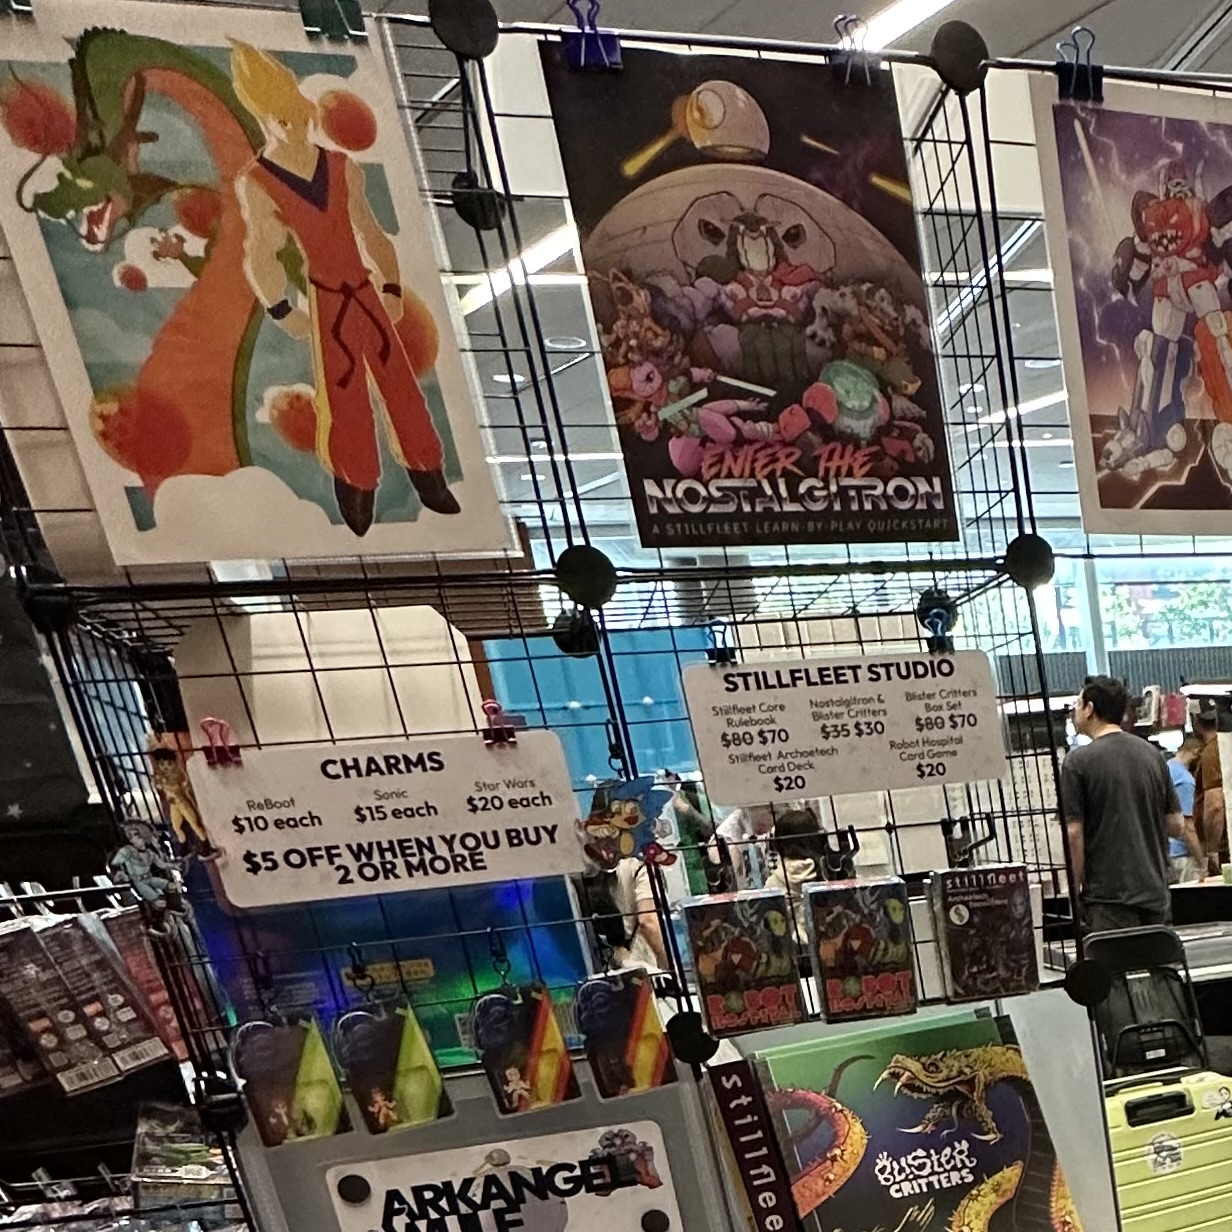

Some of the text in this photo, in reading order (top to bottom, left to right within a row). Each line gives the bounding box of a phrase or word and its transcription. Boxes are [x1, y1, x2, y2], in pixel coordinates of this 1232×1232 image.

[701, 444, 880, 480] ENTER THE
[642, 475, 945, 514] NOSTALGITRON
[666, 520, 749, 536] STILLFLEET
[868, 517, 949, 532] QUICKSTART
[723, 658, 955, 693] STILLFLEET STUDIO
[877, 694, 885, 705] &
[905, 687, 977, 702] Blister Critters
[712, 702, 785, 717] Stillfleet Core
[812, 706, 887, 722] Blister Critters
[924, 699, 962, 714] Box Set
[726, 715, 777, 729] Rulebook
[820, 720, 885, 741] $35 $30
[915, 712, 978, 733] $80 $70
[721, 728, 789, 748] $80 $70
[889, 735, 964, 752] Robot Hospital
[728, 751, 772, 764] Stillfleet
[899, 748, 958, 763] Card Game
[319, 750, 445, 781] CHARMS
[758, 760, 815, 774] Card Deck
[916, 762, 946, 780] $20
[474, 777, 536, 793] Star Wars
[773, 775, 806, 793] $20
[374, 787, 408, 801] Sonic
[466, 791, 553, 815] $20 each
[246, 796, 296, 812] ReBoot
[354, 800, 439, 825] $15 each
[231, 811, 323, 836] $10 each
[242, 822, 560, 876] $5 OFF WHEN YOU BUY
[333, 850, 488, 886] 2 OR MORE
[889, 1167, 974, 1198] CRITTERS
